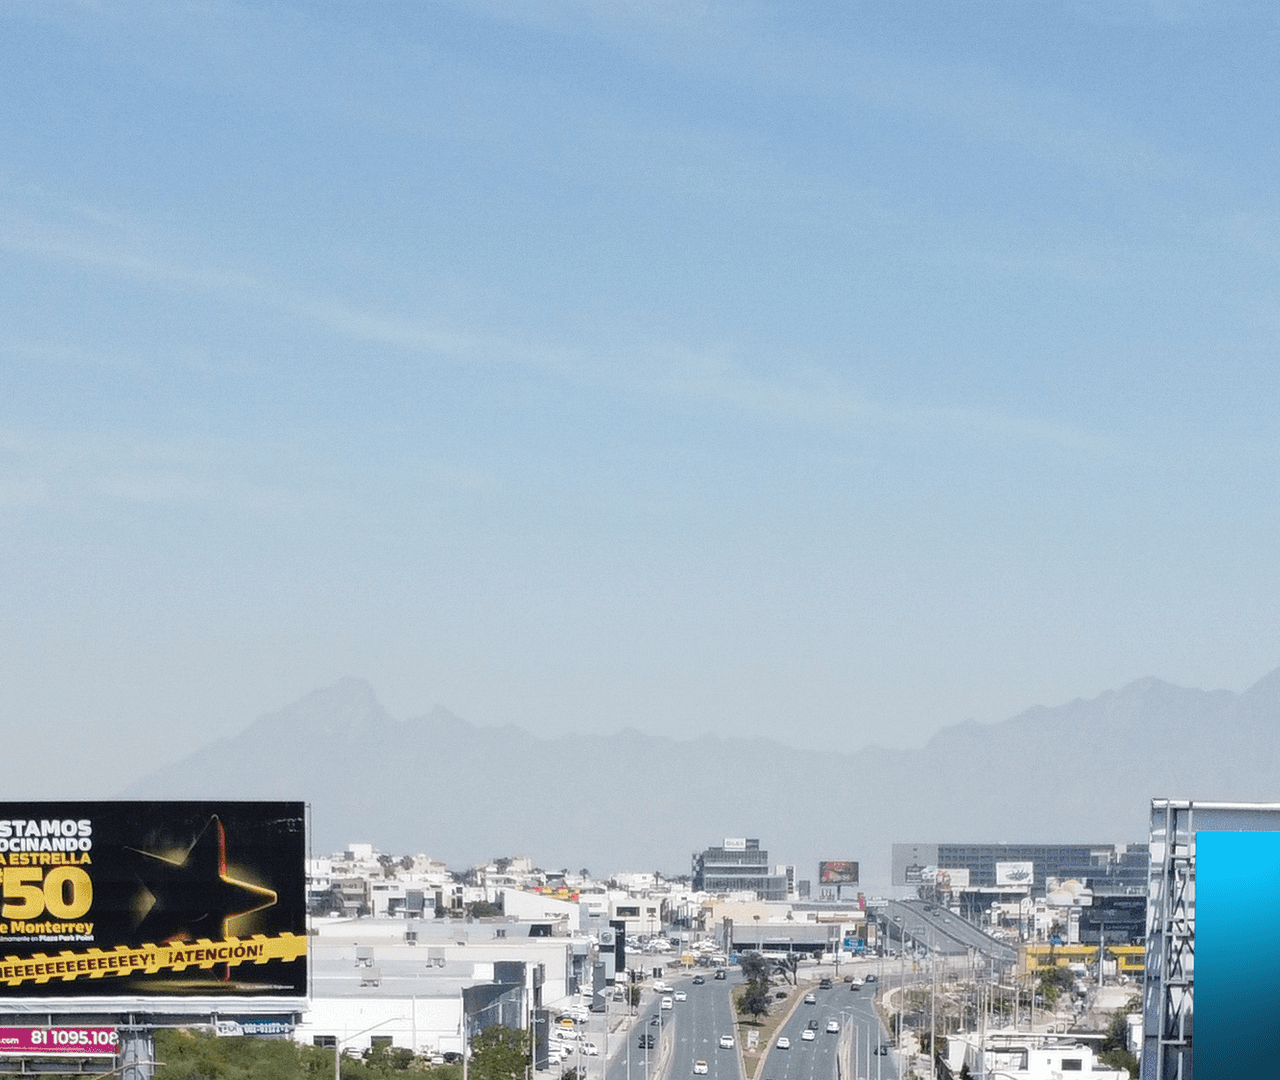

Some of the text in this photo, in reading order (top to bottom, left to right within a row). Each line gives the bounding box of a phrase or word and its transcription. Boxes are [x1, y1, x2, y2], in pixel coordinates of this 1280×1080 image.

[9, 852, 92, 865] ESTRELLA
[10, 921, 94, 935] Monterrey
[168, 942, 264, 964] ¡ATENCIÓN!
[31, 1031, 47, 1044] 81
